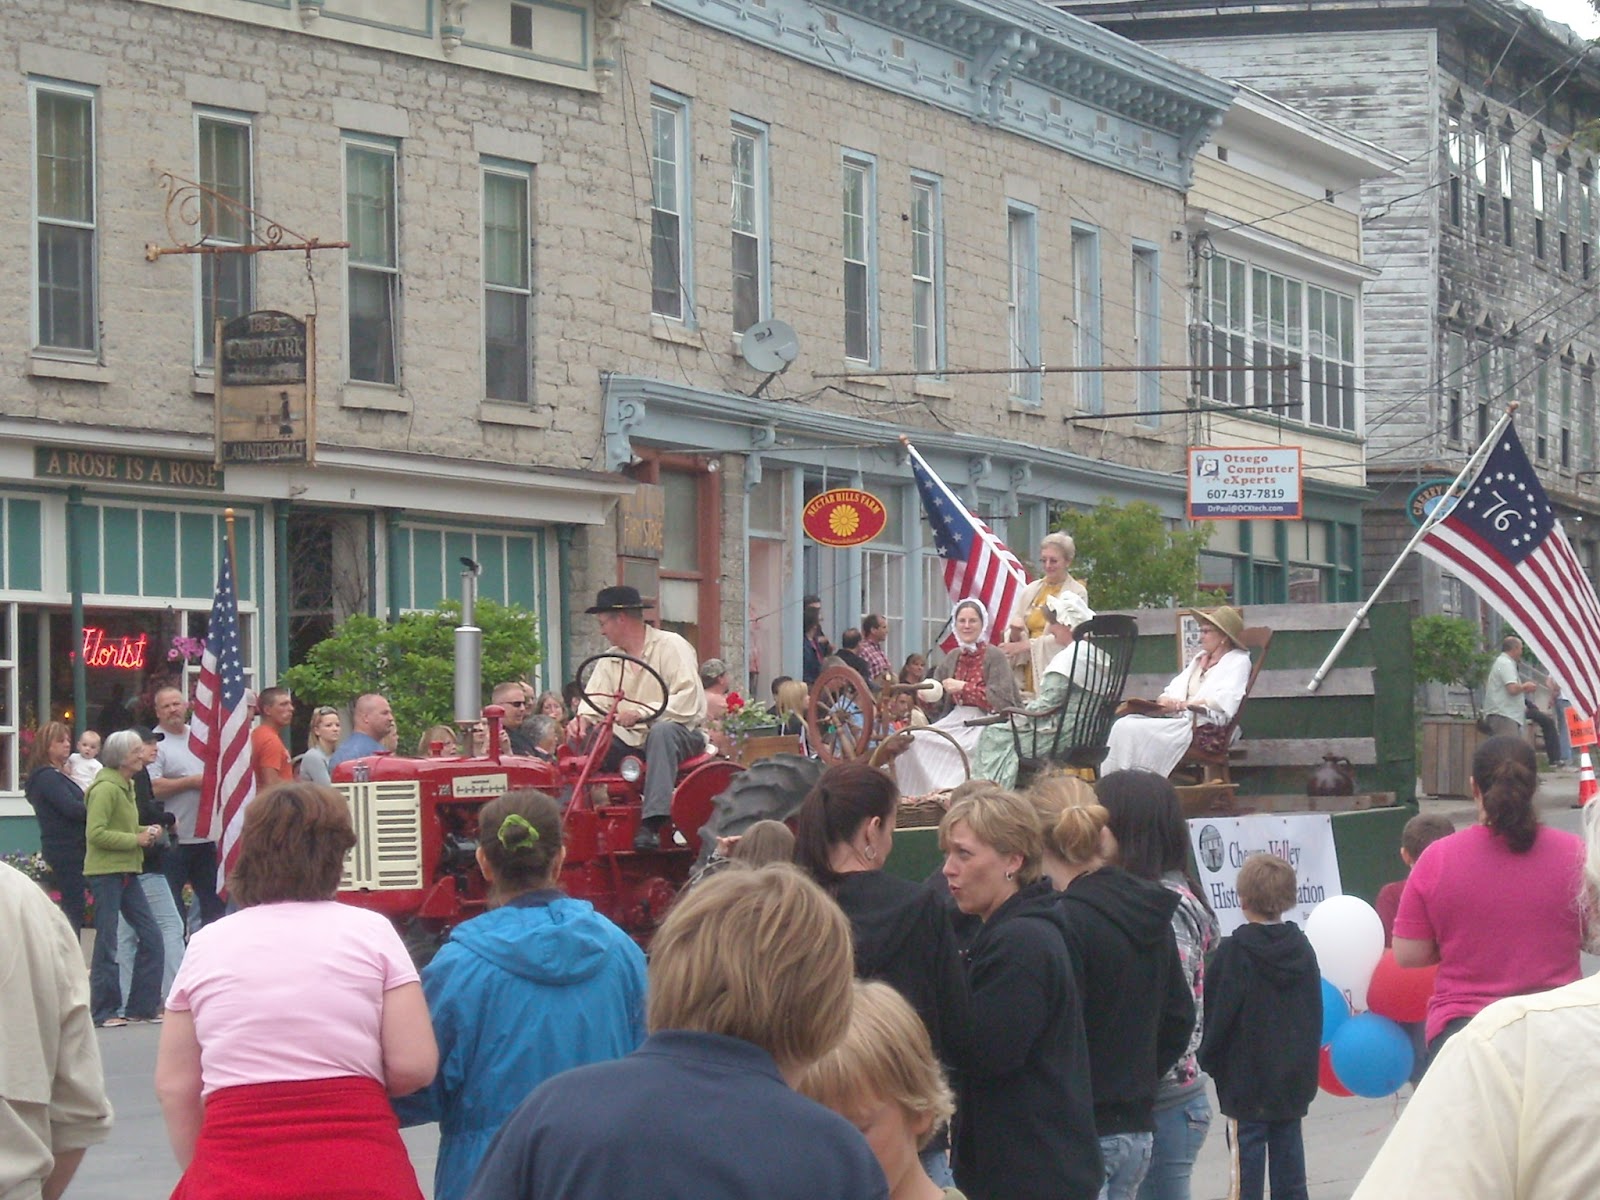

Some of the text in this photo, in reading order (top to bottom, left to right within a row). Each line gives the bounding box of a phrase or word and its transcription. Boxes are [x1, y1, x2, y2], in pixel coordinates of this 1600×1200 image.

[227, 337, 304, 359] LANDMARK
[223, 443, 305, 460] LAUNDROMAT
[1224, 454, 1269, 464] Otsego
[48, 451, 218, 487] A ROSE IS A ROSE
[1227, 465, 1295, 475] Computer
[1223, 475, 1276, 486] eXperts
[807, 492, 881, 517] NECTAR HILLS FARM
[1207, 489, 1285, 499] 607-437-7819
[1413, 486, 1442, 515] CHERRY
[1482, 490, 1522, 531] 76
[81, 627, 147, 668] Florist
